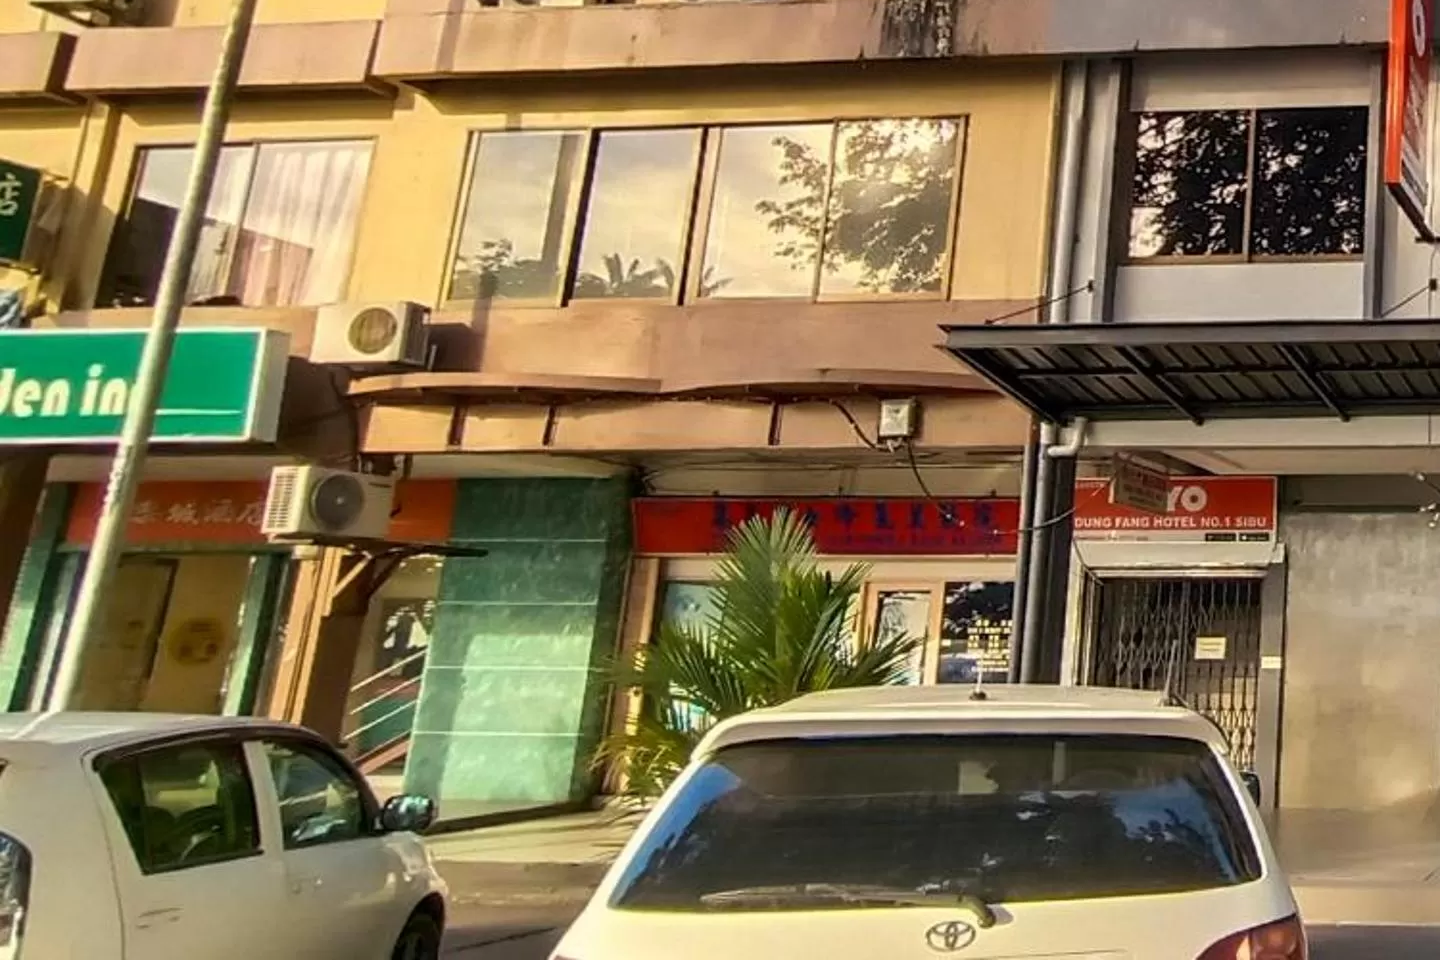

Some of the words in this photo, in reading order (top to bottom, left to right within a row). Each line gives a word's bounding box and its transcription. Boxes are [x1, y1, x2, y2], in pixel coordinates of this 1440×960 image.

[1074, 516, 1111, 528] DUNG
[1115, 516, 1149, 528] FANG
[1153, 516, 1197, 528] HOTEL
[1201, 516, 1231, 528] NO.1
[1234, 516, 1267, 528] SIBU
